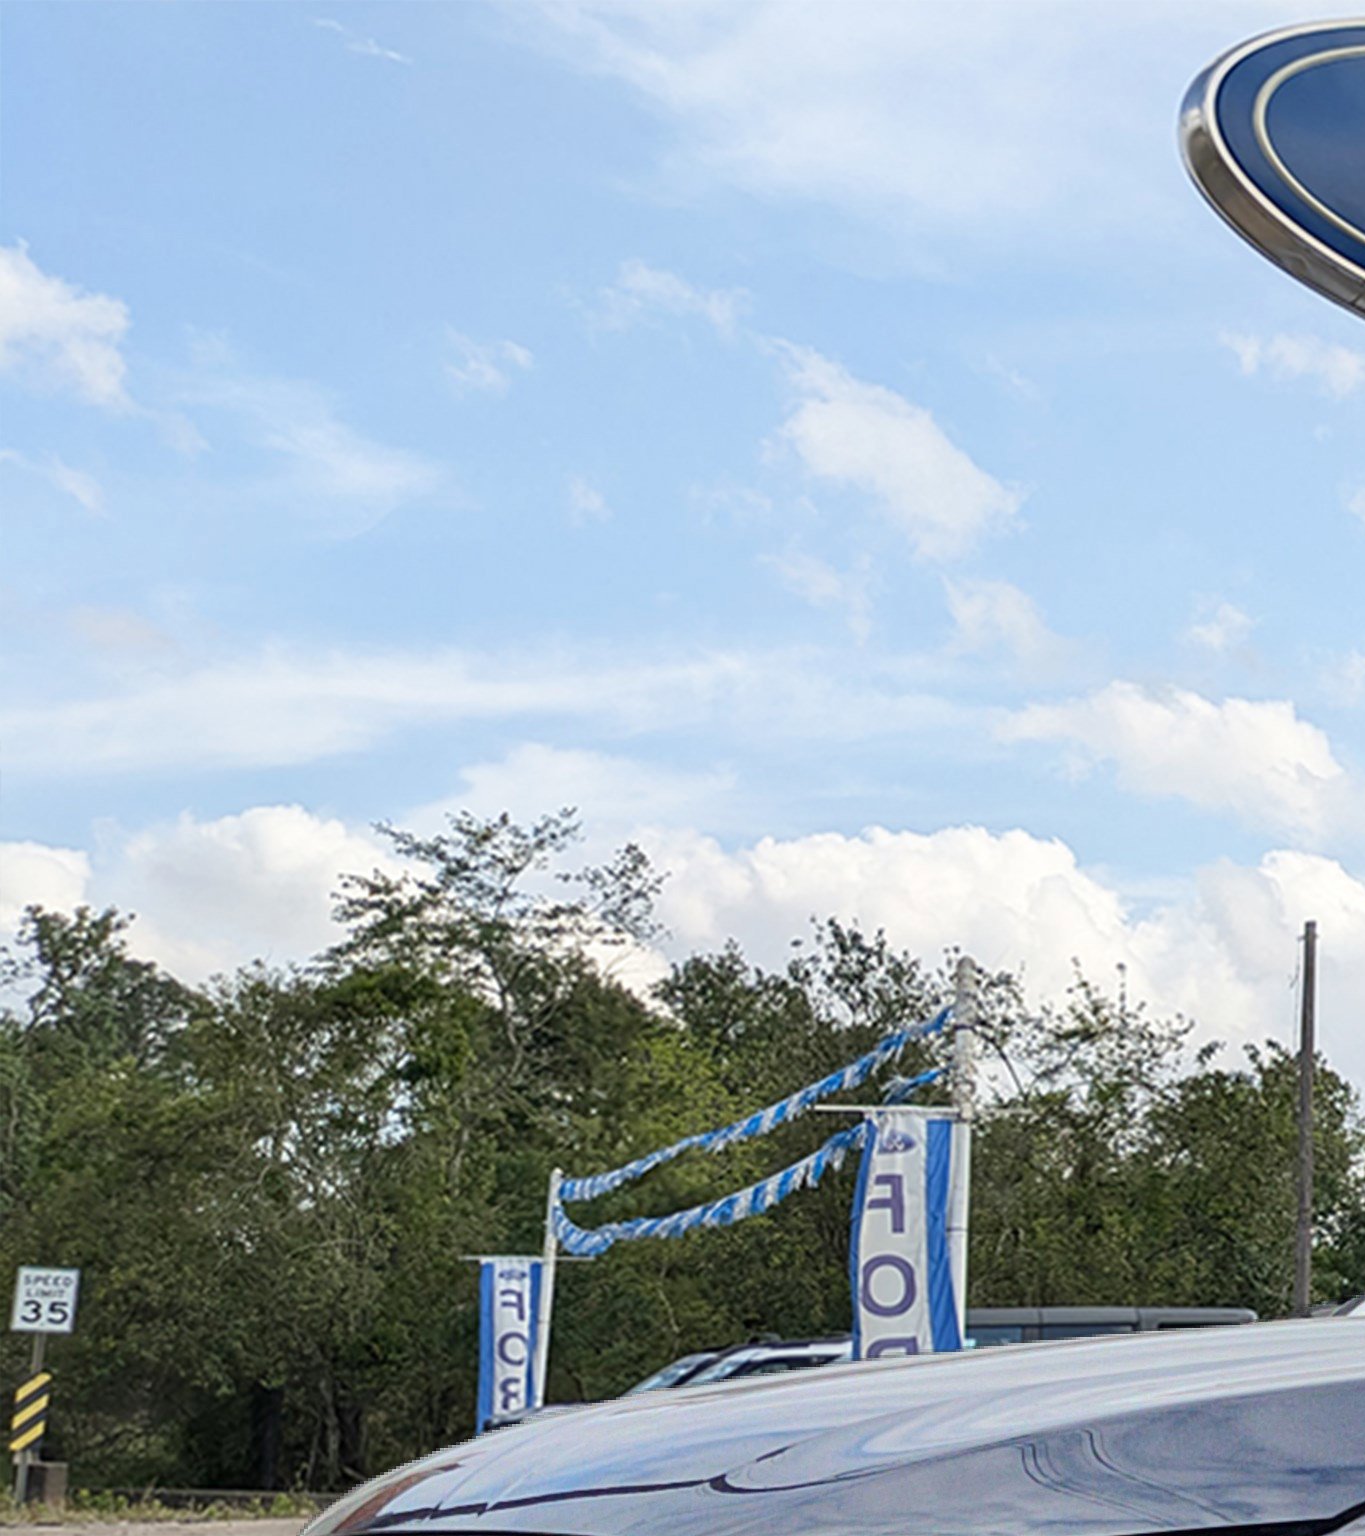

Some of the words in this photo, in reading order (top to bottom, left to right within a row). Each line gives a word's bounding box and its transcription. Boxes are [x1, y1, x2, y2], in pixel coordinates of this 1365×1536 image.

[24, 1275, 73, 1287] SPEED
[26, 1289, 65, 1298] LIMIT
[21, 1300, 68, 1324] 35
